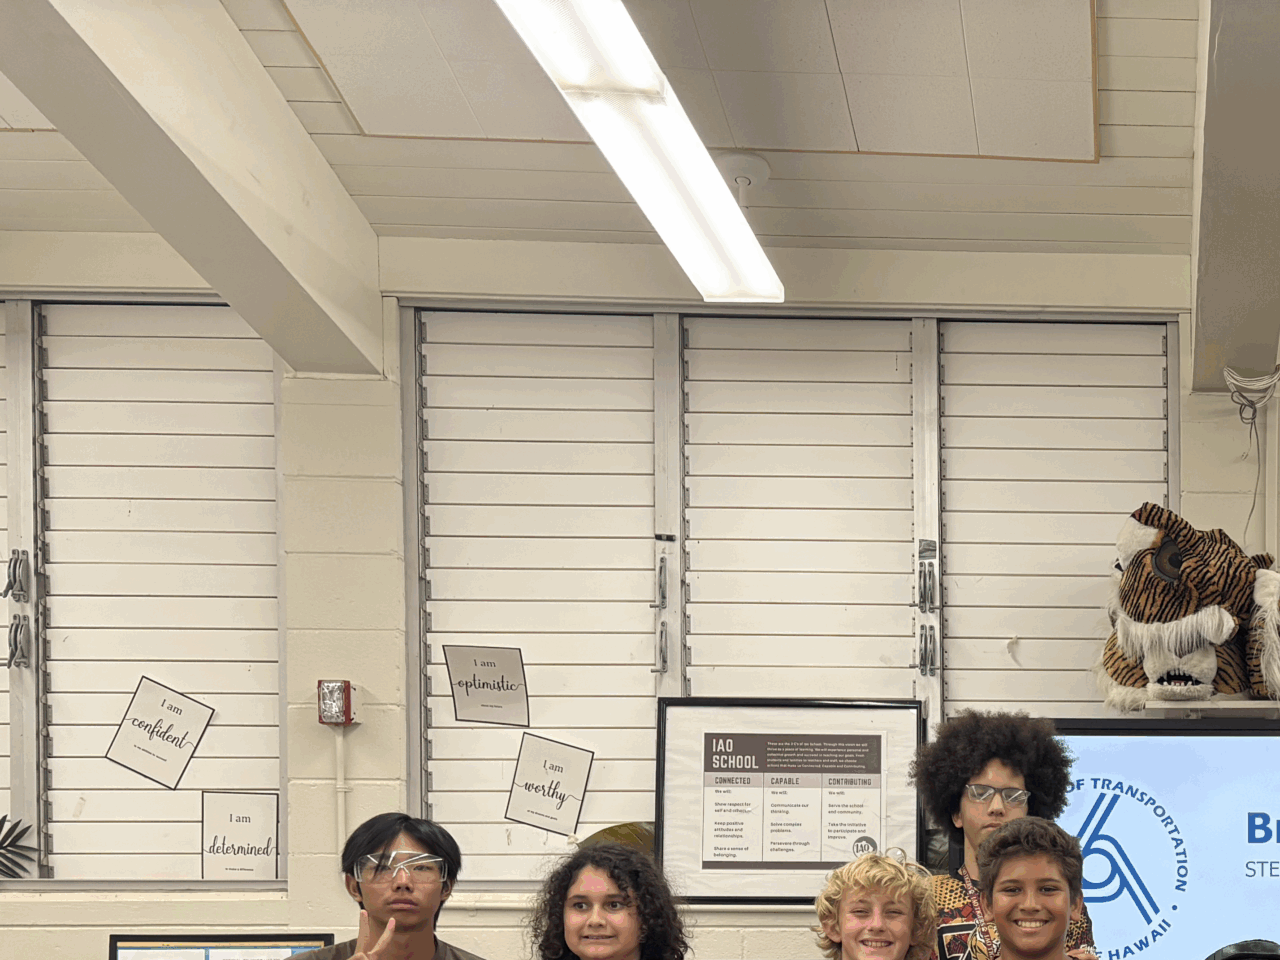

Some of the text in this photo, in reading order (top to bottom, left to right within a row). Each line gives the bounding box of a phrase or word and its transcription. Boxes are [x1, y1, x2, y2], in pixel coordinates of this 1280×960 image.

[473, 659, 496, 668] I am
[456, 673, 520, 696] optimistic
[160, 699, 183, 716] I am
[130, 718, 191, 749] confident
[712, 738, 733, 752] IAO
[543, 760, 564, 773] I am
[712, 755, 759, 769] SCHOOL
[714, 777, 751, 785] CONNECTED
[771, 777, 800, 785] CAPABLE
[828, 778, 872, 786] CONTRIBUTING
[522, 780, 569, 810] worthy
[229, 814, 251, 823] I am
[1090, 777, 1189, 892] TRANSPORTATION
[206, 835, 273, 857] determined
